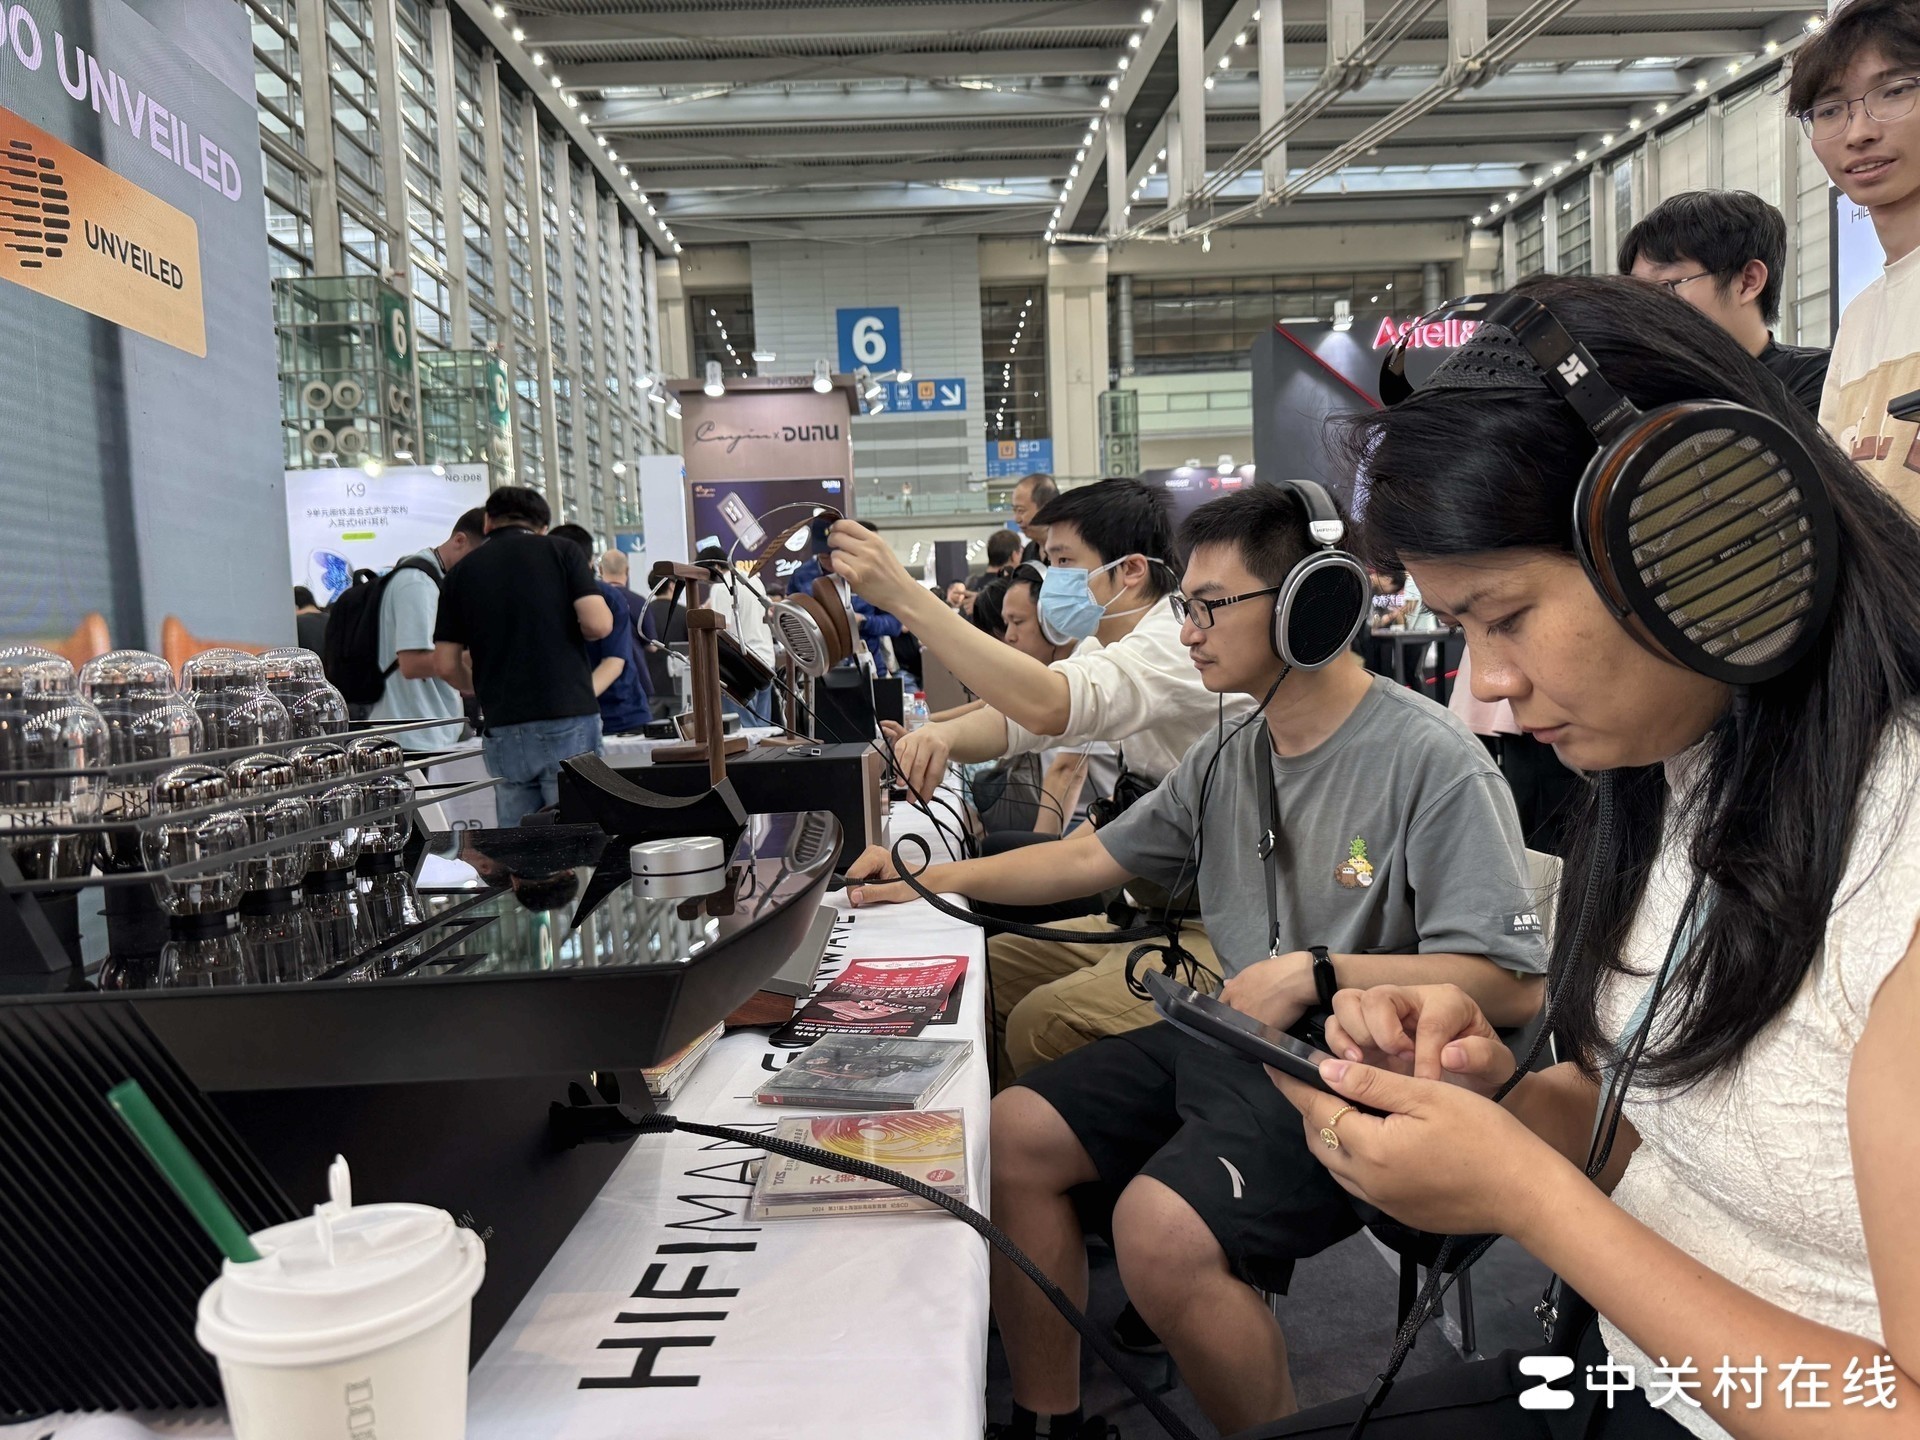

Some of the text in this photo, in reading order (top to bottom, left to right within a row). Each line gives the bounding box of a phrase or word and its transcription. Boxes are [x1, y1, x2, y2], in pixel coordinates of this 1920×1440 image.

[54, 31, 242, 201] UNVEILED
[84, 219, 183, 290] UNVEILED
[392, 308, 407, 355] 6
[852, 316, 887, 365] 6
[1592, 401, 1629, 432] SHANGRI-LA
[346, 483, 366, 498] K9
